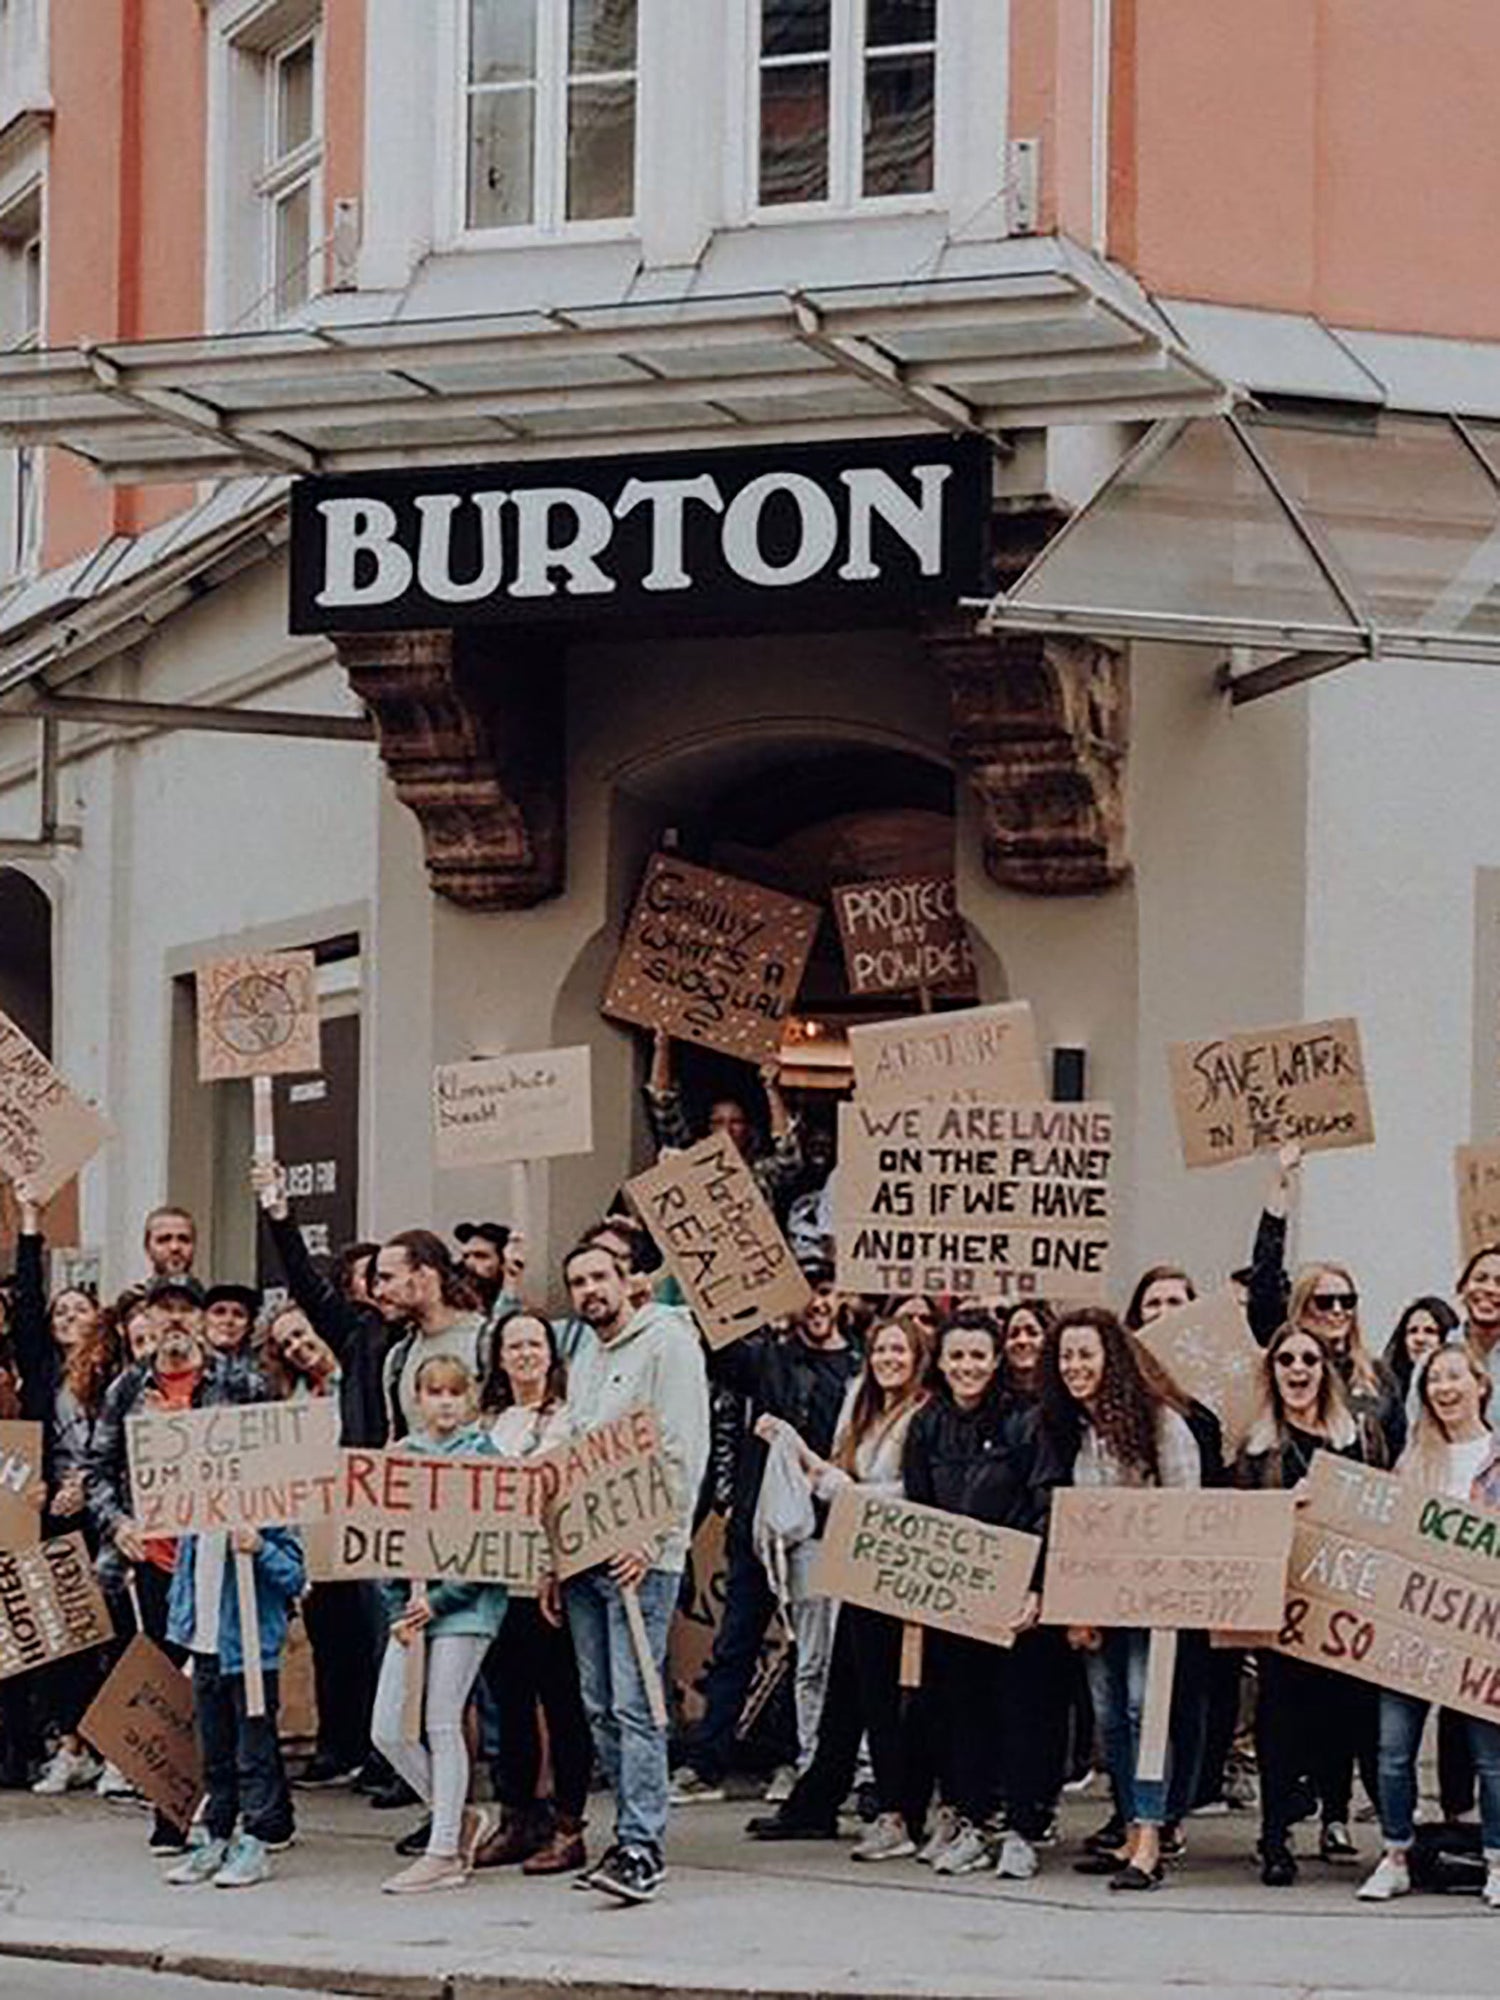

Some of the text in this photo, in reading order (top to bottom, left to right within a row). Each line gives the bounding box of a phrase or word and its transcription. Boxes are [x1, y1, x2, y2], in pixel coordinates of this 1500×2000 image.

[315, 465, 952, 607] BURTON
[842, 882, 952, 935] PROTEC
[1193, 1041, 1266, 1112] SAVE
[860, 1109, 920, 1137] WE
[938, 1109, 1005, 1140] ARE
[879, 1149, 1111, 1181] ON THE PLANET
[871, 1181, 1106, 1217] AS IF WE HAVE
[852, 1230, 1109, 1272] ANOTHER ONE
[877, 1265, 1036, 1295] TO GO TO
[134, 1403, 308, 1466] ES GEHT
[541, 1411, 654, 1502] DANKE
[137, 1456, 241, 1490] UM DIE
[144, 1475, 336, 1531] ZUKUNFT
[346, 1454, 545, 1516] RETTET
[555, 1453, 674, 1556] GRETA
[861, 1499, 1001, 1561] PROTECT.
[1331, 1469, 1500, 1560] THE OCEA
[343, 1525, 407, 1567] DIE
[853, 1532, 997, 1592] RESTORE.
[874, 1570, 967, 1614] FUND.
[1300, 1547, 1380, 1600] ARE
[1399, 1571, 1500, 1645] RISIN
[1277, 1598, 1309, 1646] &
[1320, 1610, 1377, 1662] SO
